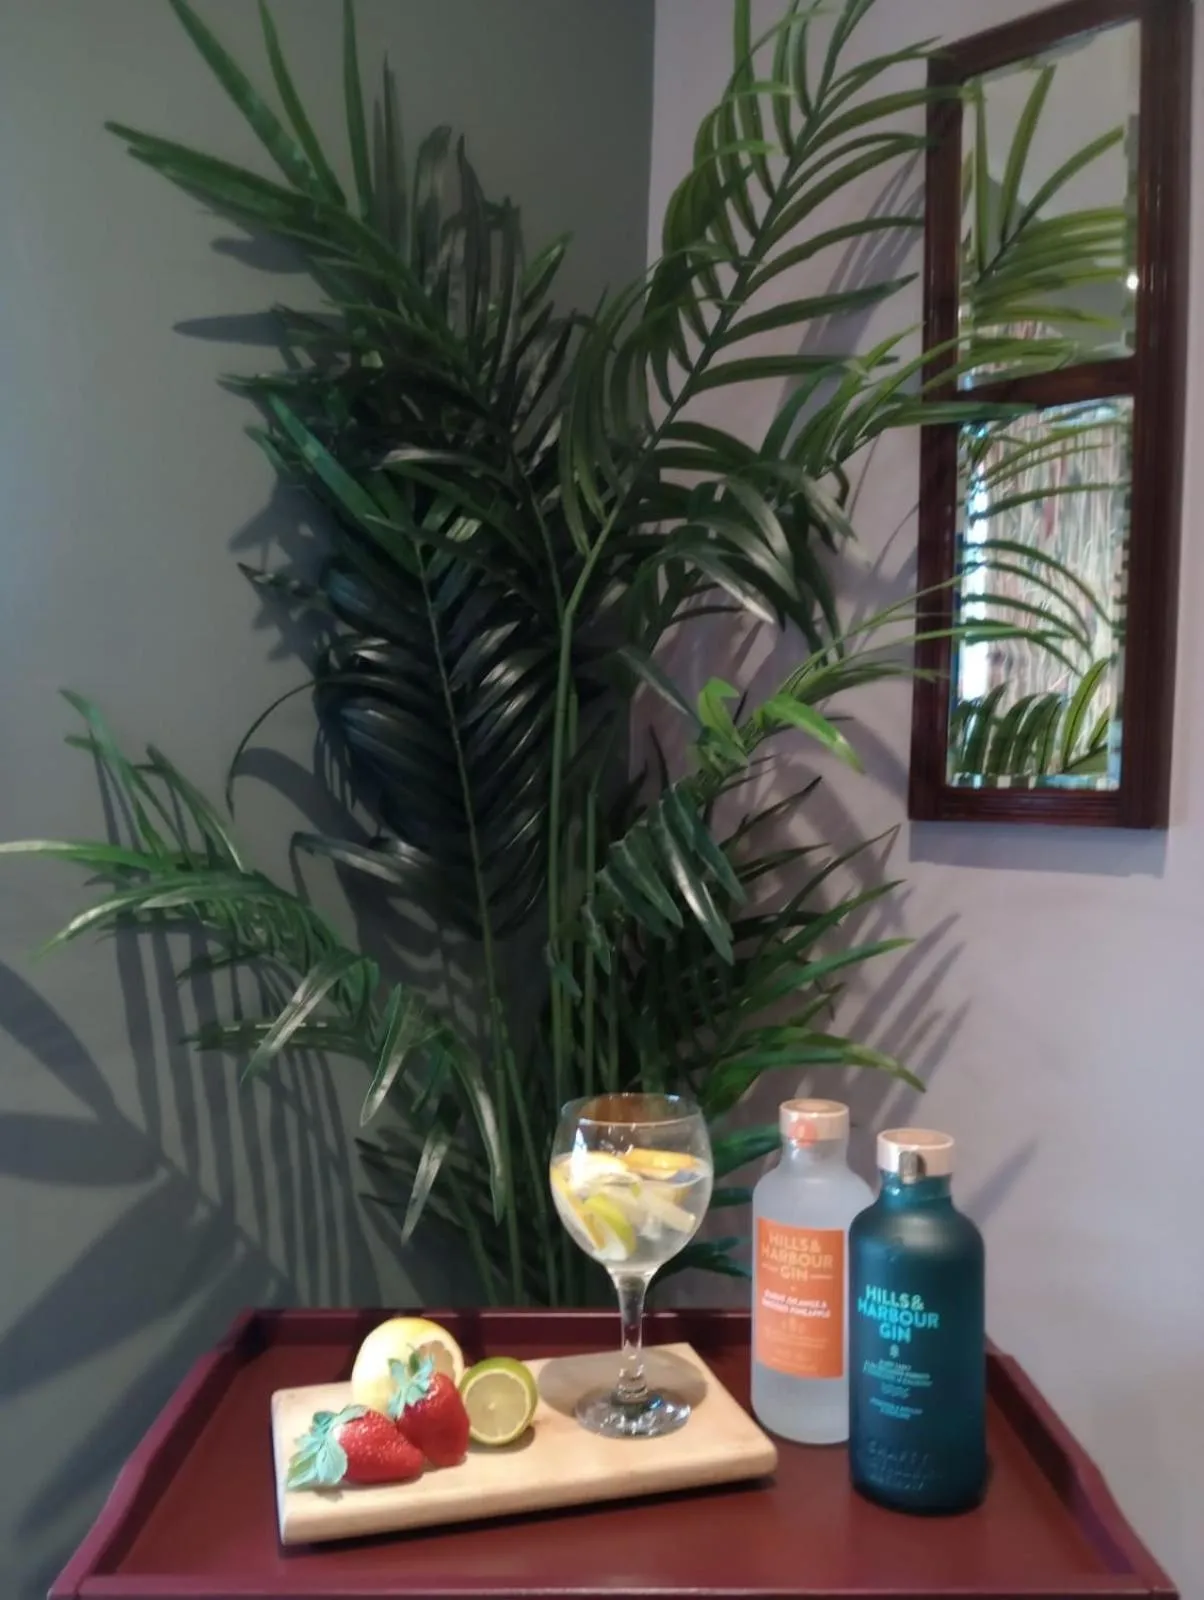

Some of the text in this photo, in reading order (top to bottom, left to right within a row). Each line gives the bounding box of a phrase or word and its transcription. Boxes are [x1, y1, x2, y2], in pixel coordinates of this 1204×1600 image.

[769, 1231, 821, 1253] HILLS&
[762, 1240, 834, 1269] HARBOUR
[780, 1265, 808, 1282] GIN
[865, 1284, 925, 1311] HILLS&
[857, 1298, 940, 1330] HARBOUR
[879, 1323, 912, 1344] GIN
